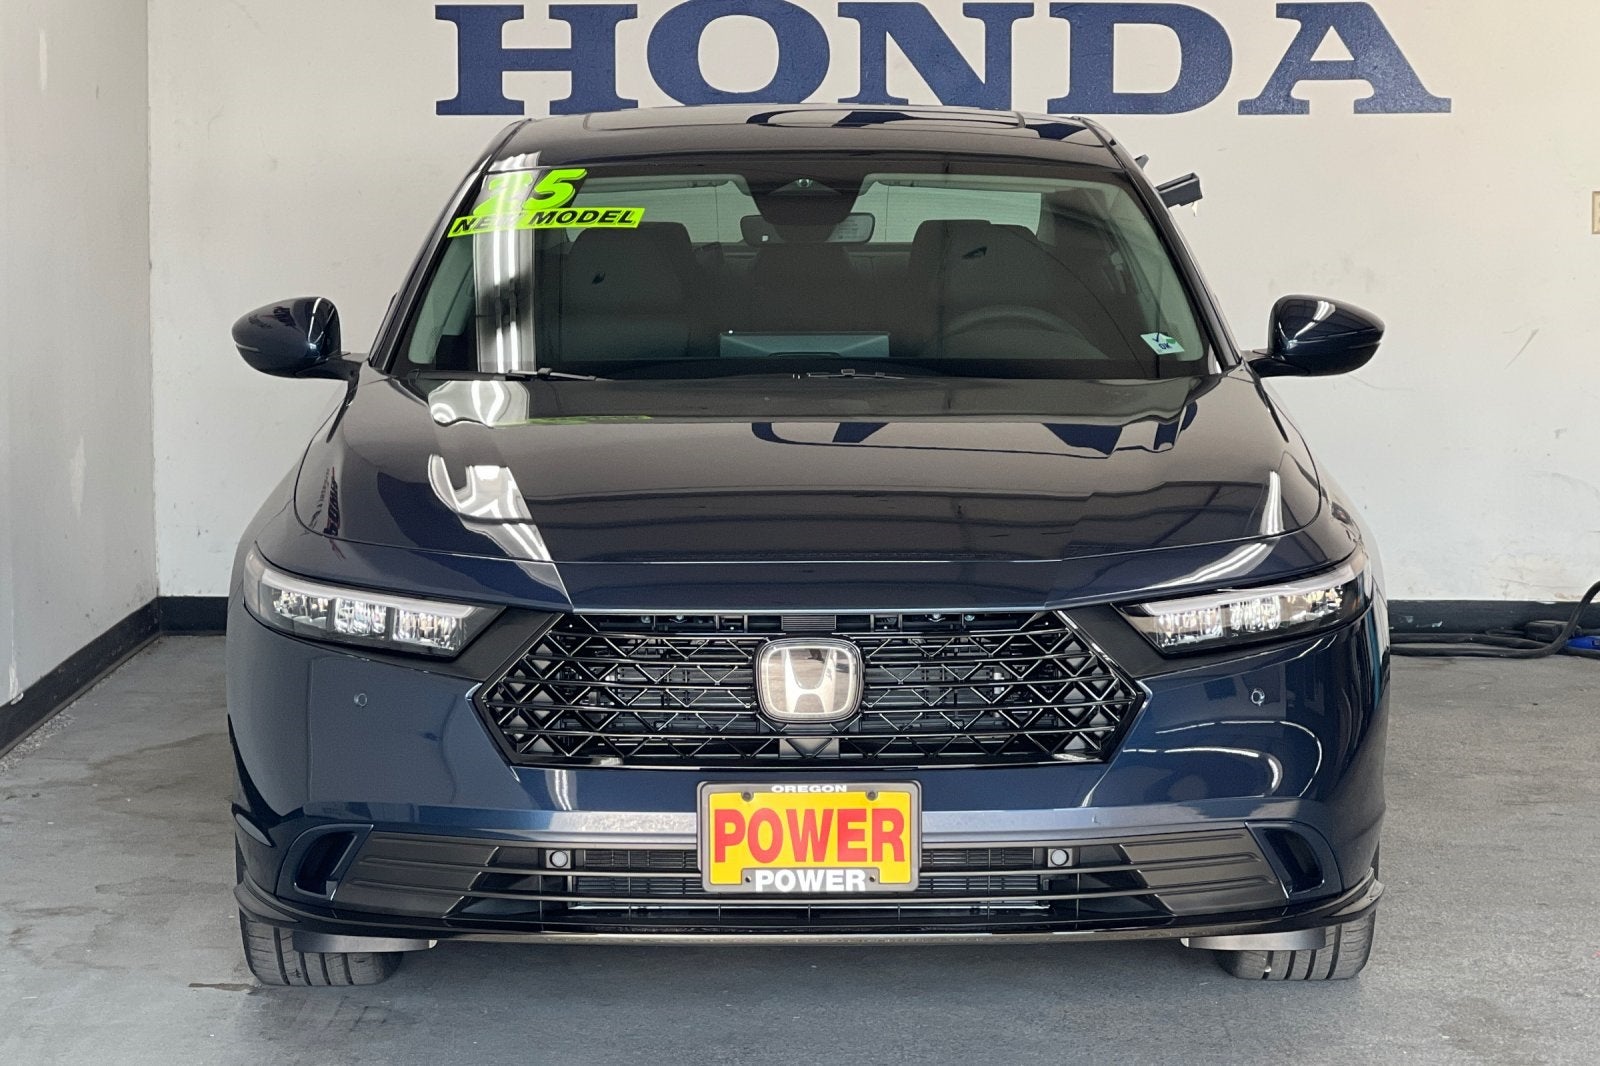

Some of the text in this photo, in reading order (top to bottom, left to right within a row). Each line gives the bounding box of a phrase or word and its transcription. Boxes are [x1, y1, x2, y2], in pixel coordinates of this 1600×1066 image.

[436, 0, 1452, 115] HONDA
[473, 168, 588, 217] 25
[528, 209, 636, 226] MODEL
[770, 784, 848, 793] OREGON
[713, 807, 906, 864] POWER
[754, 868, 867, 892] POWER
